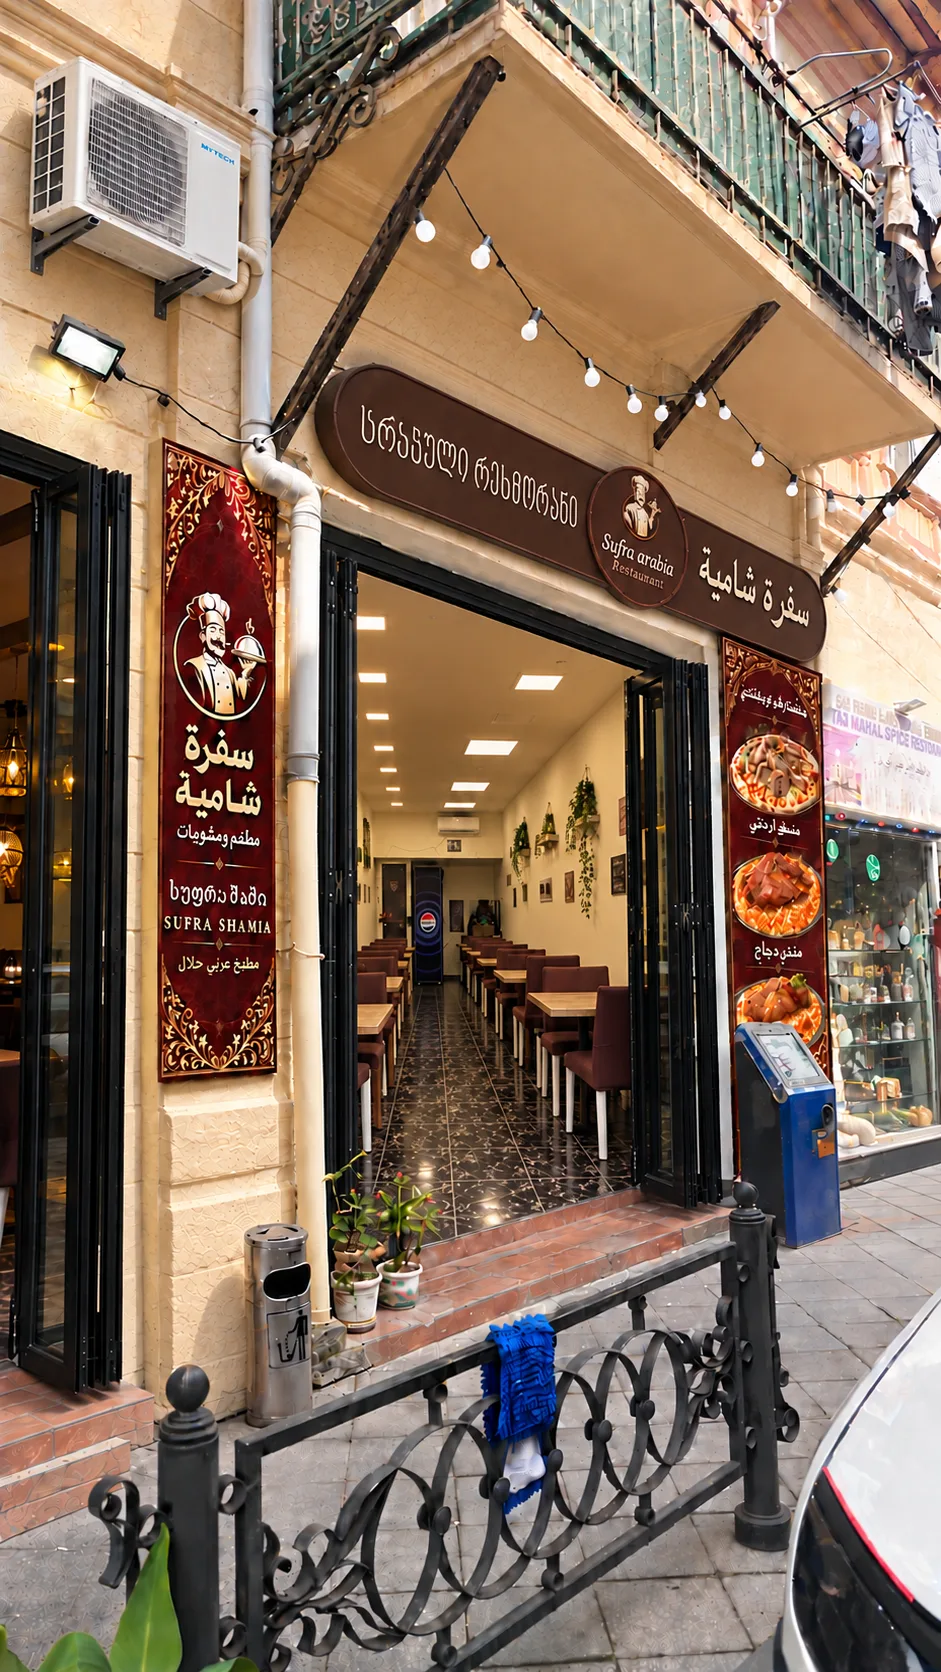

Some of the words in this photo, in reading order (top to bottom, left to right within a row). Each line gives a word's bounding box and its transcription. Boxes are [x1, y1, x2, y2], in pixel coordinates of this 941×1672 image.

[601, 532, 635, 559] Sufra
[637, 552, 674, 577] arabia
[699, 546, 756, 604] شامية
[763, 578, 810, 629] سفرة
[185, 723, 254, 775] سفرة
[832, 708, 849, 728] TAJ
[850, 714, 884, 739] MAHAL
[885, 726, 910, 748] SPICE
[175, 770, 262, 819] شامية
[164, 915, 213, 932] SUFRA
[218, 918, 271, 934] SHAMIA
[178, 955, 204, 973] حلال
[754, 940, 779, 965] دجاج
